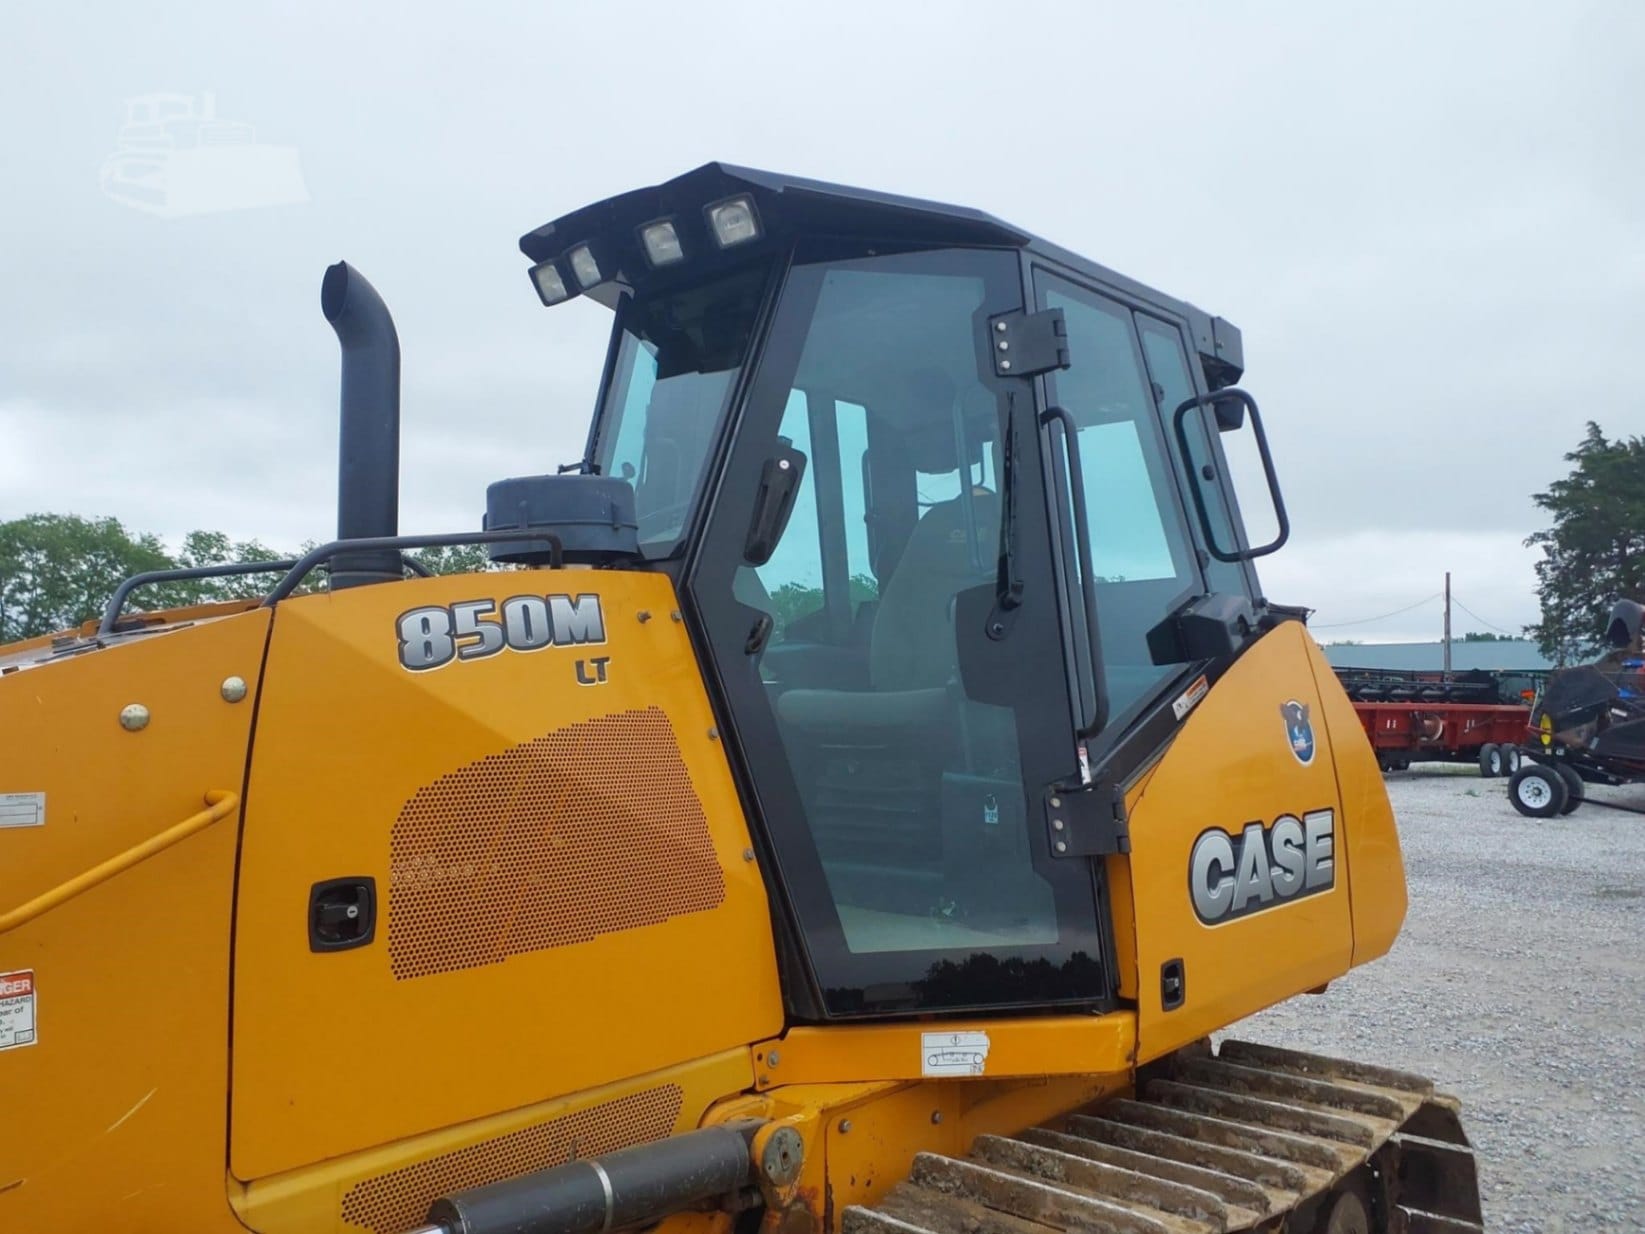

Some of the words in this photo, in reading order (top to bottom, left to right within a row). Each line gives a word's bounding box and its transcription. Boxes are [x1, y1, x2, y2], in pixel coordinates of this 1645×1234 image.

[396, 593, 606, 671] 850M
[575, 656, 609, 684] LT
[1189, 807, 1334, 922] CASE
[0, 980, 31, 995] GER
